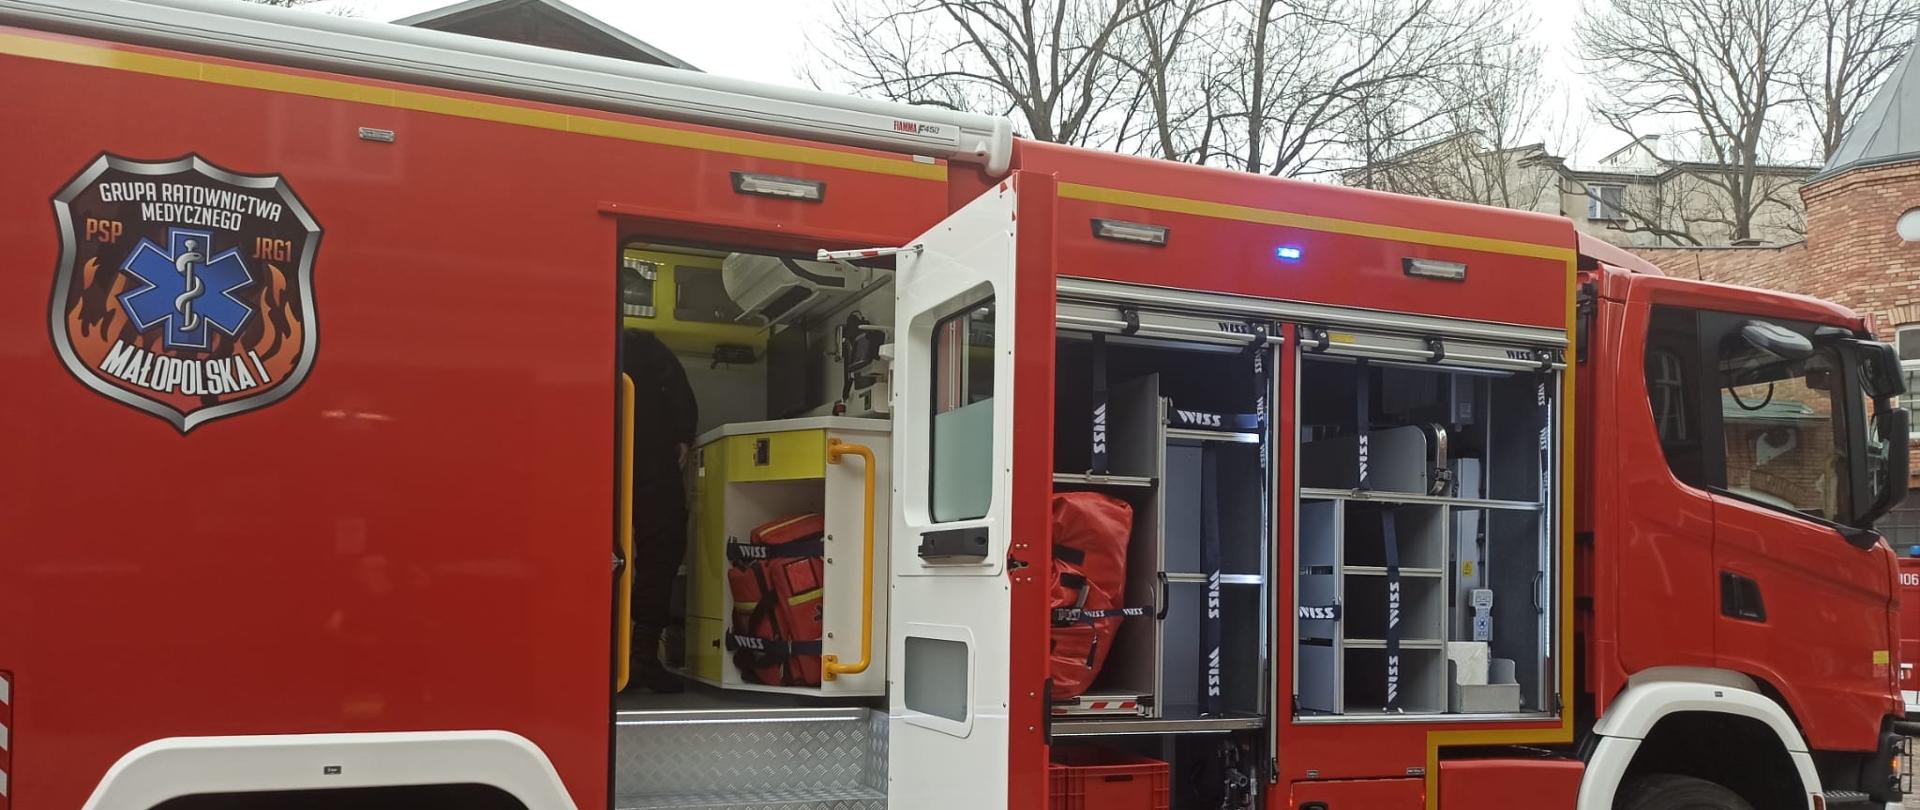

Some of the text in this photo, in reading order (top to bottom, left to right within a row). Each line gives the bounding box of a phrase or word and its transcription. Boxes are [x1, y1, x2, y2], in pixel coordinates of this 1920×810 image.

[893, 120, 917, 133] FIAMMA
[99, 182, 282, 223] GRUPA RATOWNICTWA
[141, 202, 242, 232] MEDYCZNEGO
[86, 218, 123, 244] PSP
[253, 237, 291, 262] JRG1
[1218, 321, 1248, 333] WISS
[99, 339, 270, 395] MAŁOPOLSKA 1
[1506, 350, 1531, 361] WISS
[1177, 410, 1222, 427] WISS
[1256, 396, 1264, 422] WISS
[1093, 402, 1106, 454] WISS
[1359, 434, 1368, 482] WISS
[739, 545, 767, 559] WISS
[1208, 569, 1220, 619] WISS
[1389, 581, 1400, 629] WISS
[1122, 607, 1144, 616] WISS
[734, 634, 765, 650] WISS
[1208, 646, 1220, 697] WISS
[1388, 655, 1399, 703] WISS
